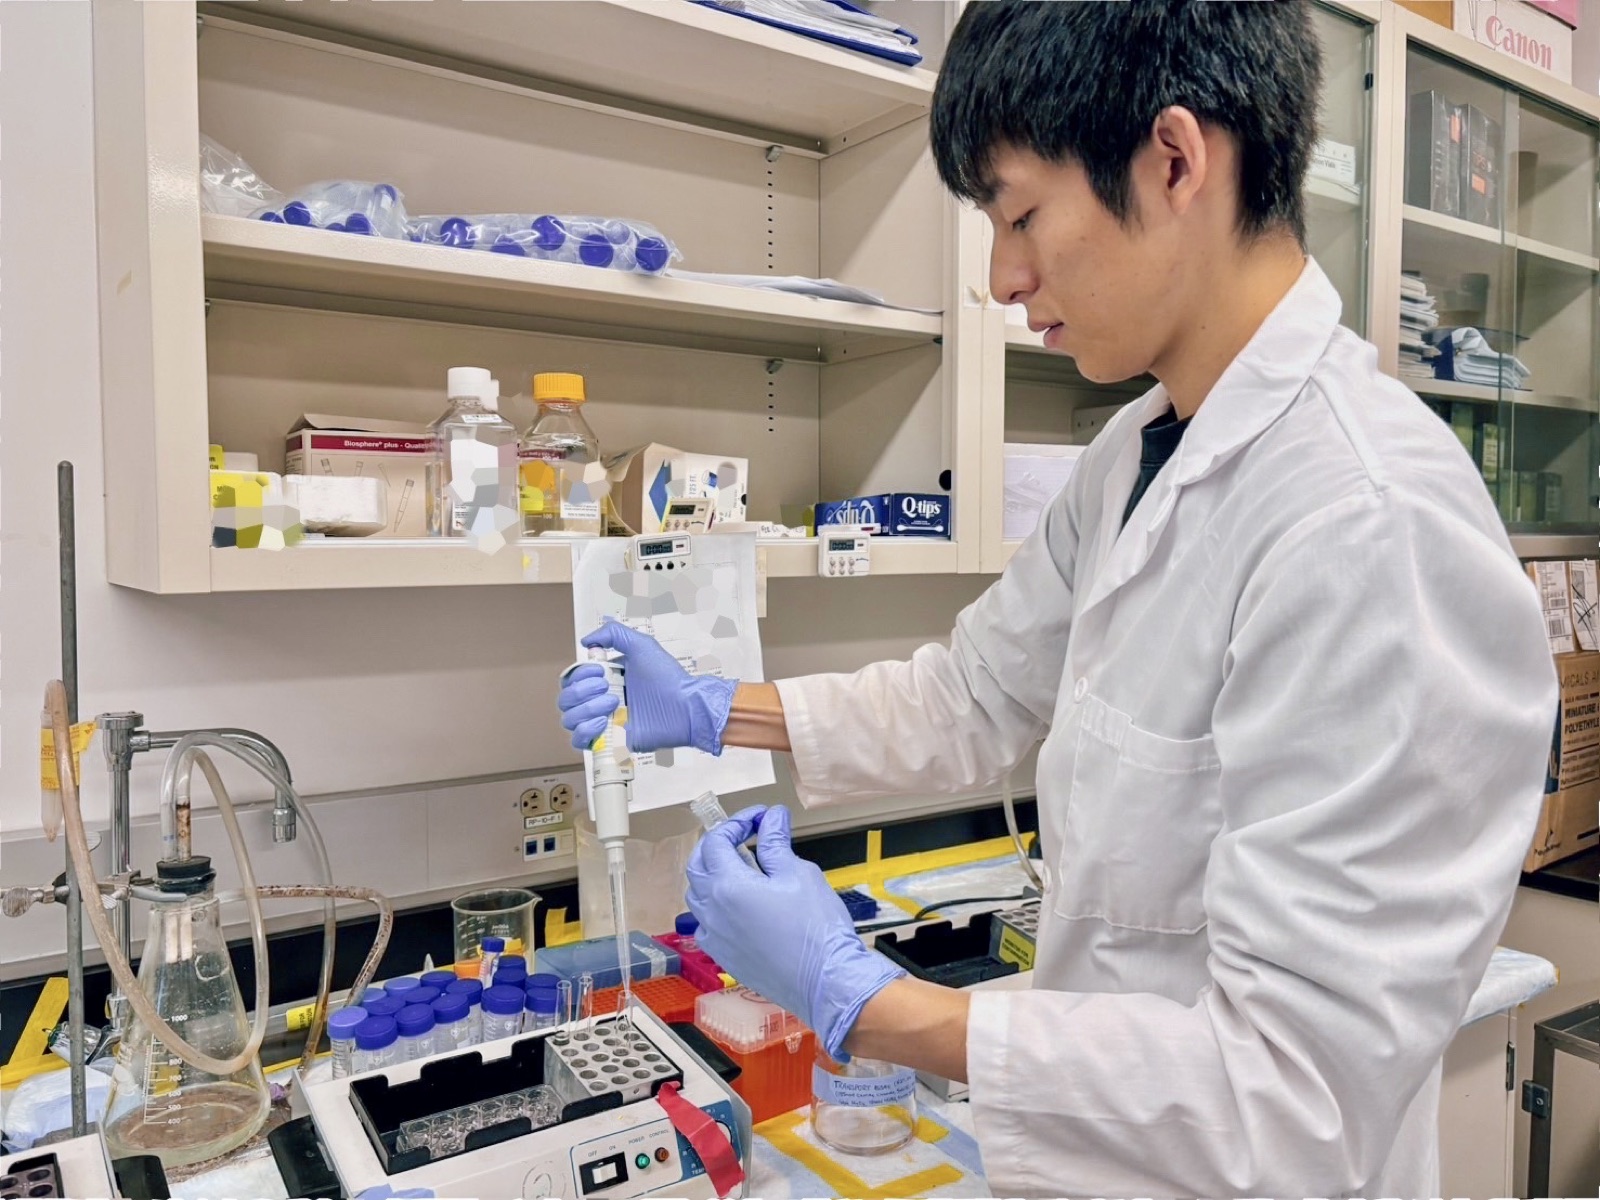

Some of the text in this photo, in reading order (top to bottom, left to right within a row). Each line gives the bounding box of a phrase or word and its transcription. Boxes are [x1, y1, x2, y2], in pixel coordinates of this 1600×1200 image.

[1485, 15, 1552, 71] Canon
[384, 441, 399, 449] plus
[902, 496, 942, 519] Q-tips
[171, 1014, 188, 1022] 1000
[833, 1080, 871, 1092] TRANSPORT
[168, 1104, 181, 1112] 500
[648, 1129, 669, 1139] CONTROL
[628, 1135, 645, 1145] POWER
[587, 1150, 598, 1158] OFF
